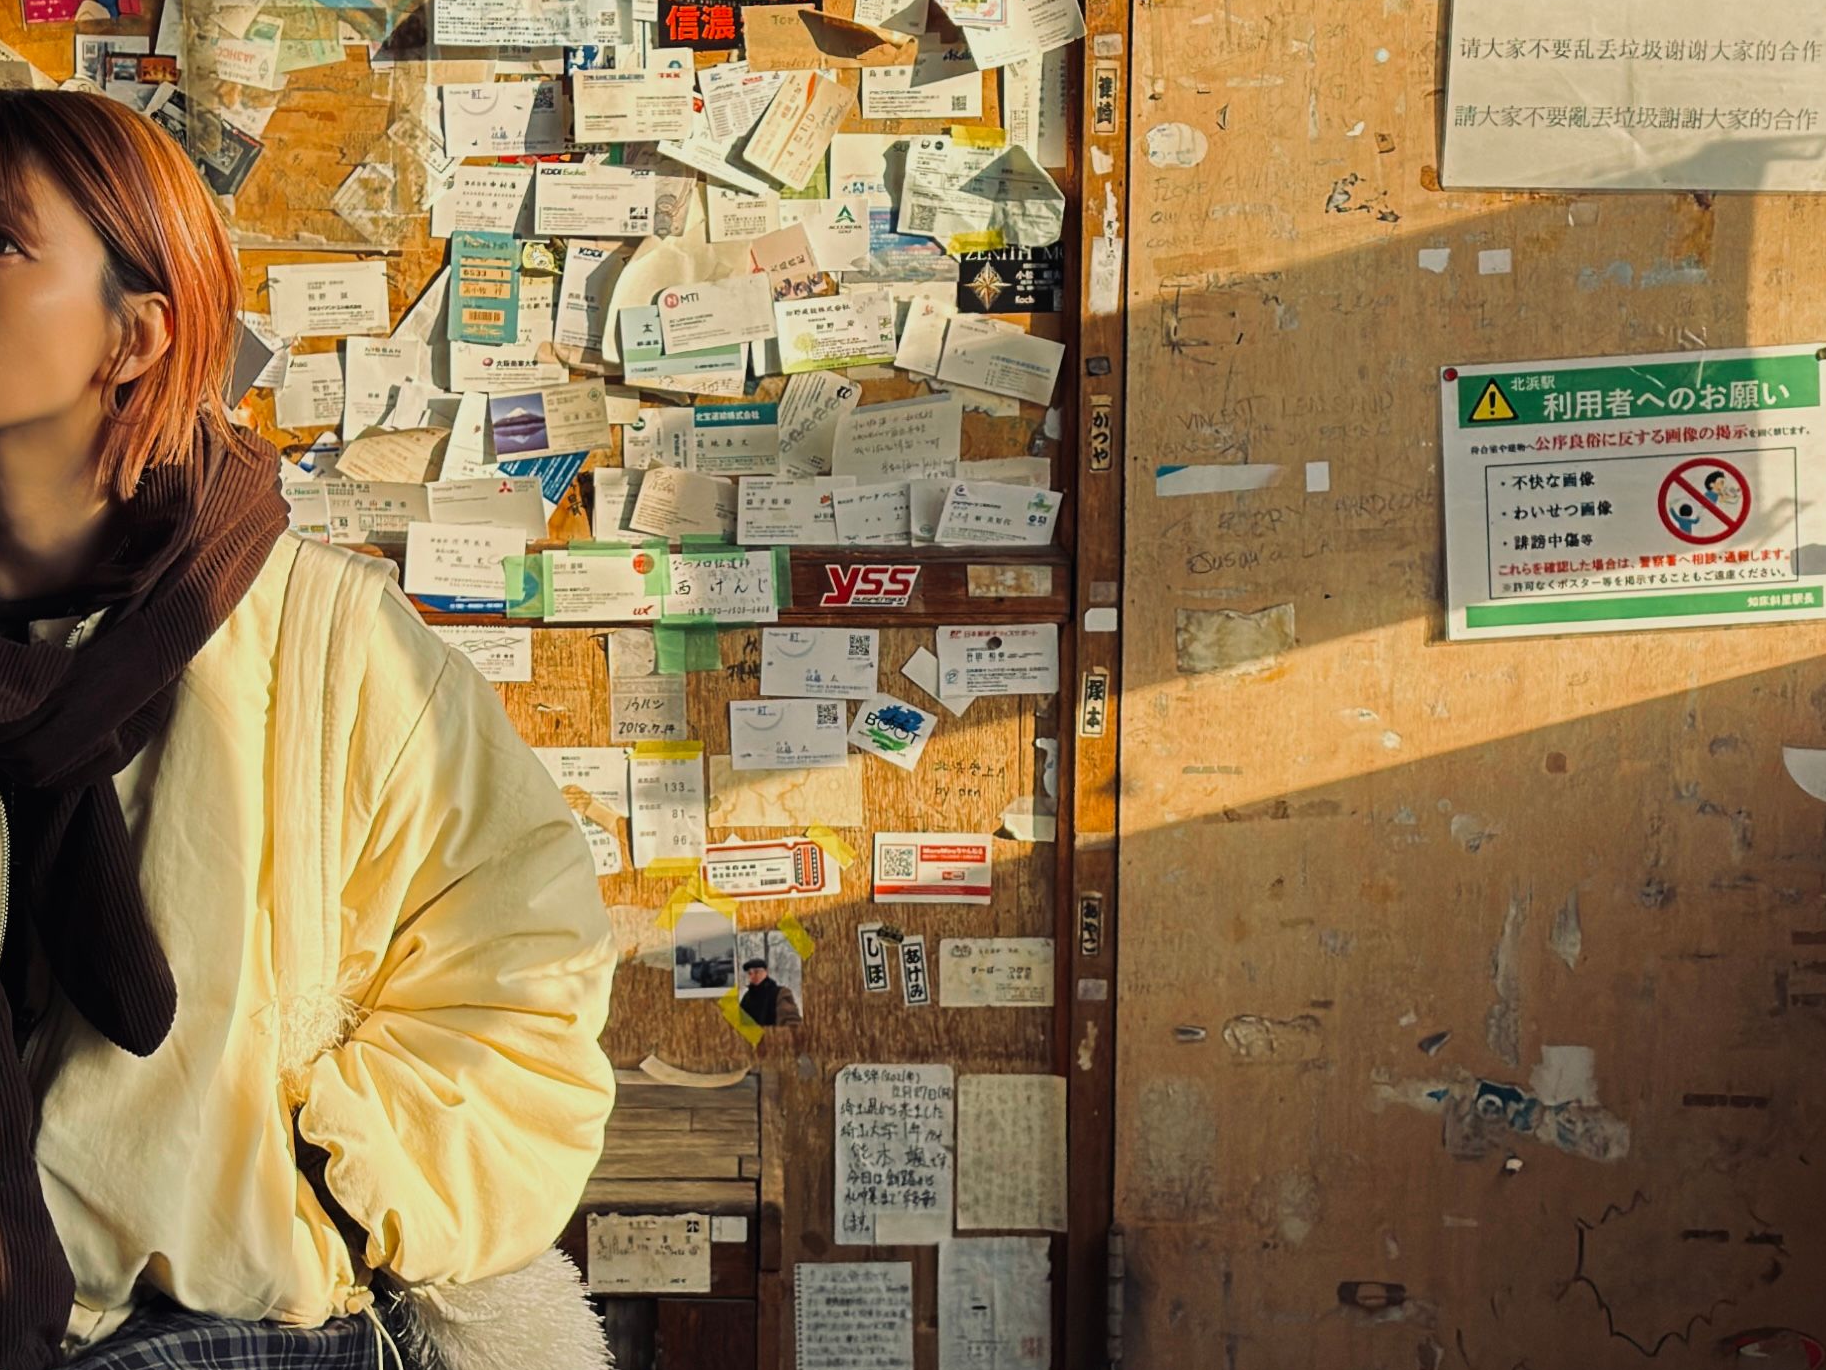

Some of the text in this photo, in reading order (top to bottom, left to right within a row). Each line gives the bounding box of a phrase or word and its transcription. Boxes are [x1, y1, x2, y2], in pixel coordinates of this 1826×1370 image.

[665, 5, 737, 42] 信濃
[1459, 38, 1824, 63] 请大家不要乱丢垃圾谢谢大家的合作
[679, 292, 700, 305] MTI
[1510, 375, 1556, 392] 北浜駅
[1543, 379, 1791, 421] 利用者へのお願い
[1091, 408, 1112, 469] かつや
[1512, 470, 1596, 491] 不快な画像
[1514, 500, 1614, 520] わいせつ画像
[1498, 548, 1792, 576] これらを確認した場合は、警察署へ相談・通報します。
[664, 782, 686, 794] 133
[672, 808, 686, 820] 81
[673, 834, 687, 847] 96
[903, 947, 927, 998] あけみ
